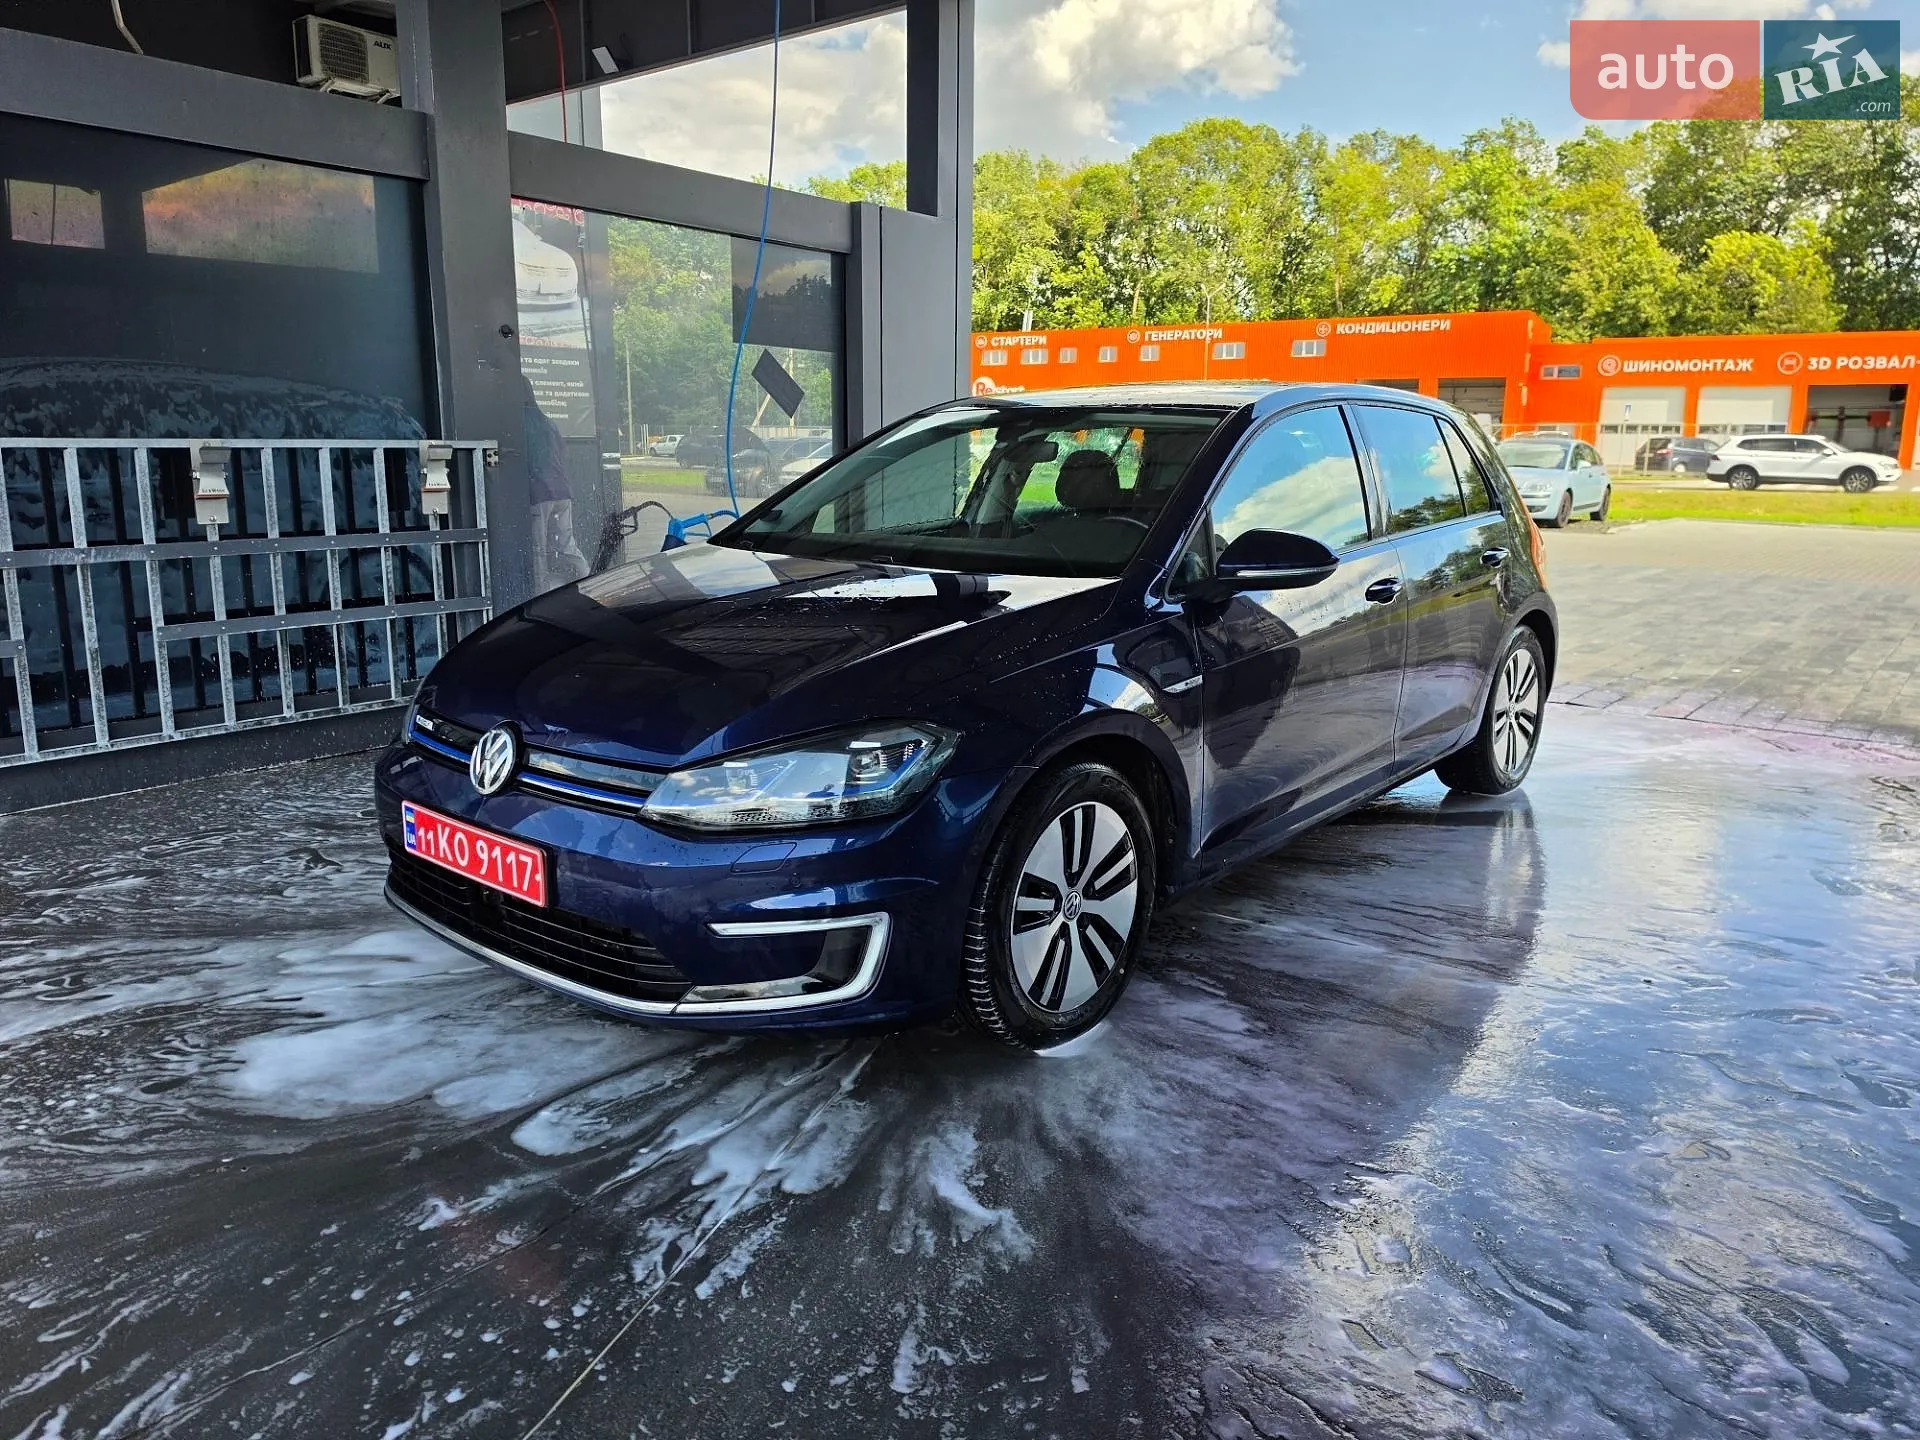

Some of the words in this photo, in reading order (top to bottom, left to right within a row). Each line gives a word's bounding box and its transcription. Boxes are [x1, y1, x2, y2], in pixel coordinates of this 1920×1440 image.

[373, 40, 392, 50] AUX
[1336, 318, 1451, 335] КОНДИЦІОНЕРИ
[991, 335, 1047, 347] СТАРТЕРИ
[1144, 328, 1223, 342] ГЕНЕРАТОРИ
[1622, 358, 1754, 373] ШИНОМОНТАЖ
[1807, 356, 1832, 370] 3D
[475, 840, 534, 892] 9117
